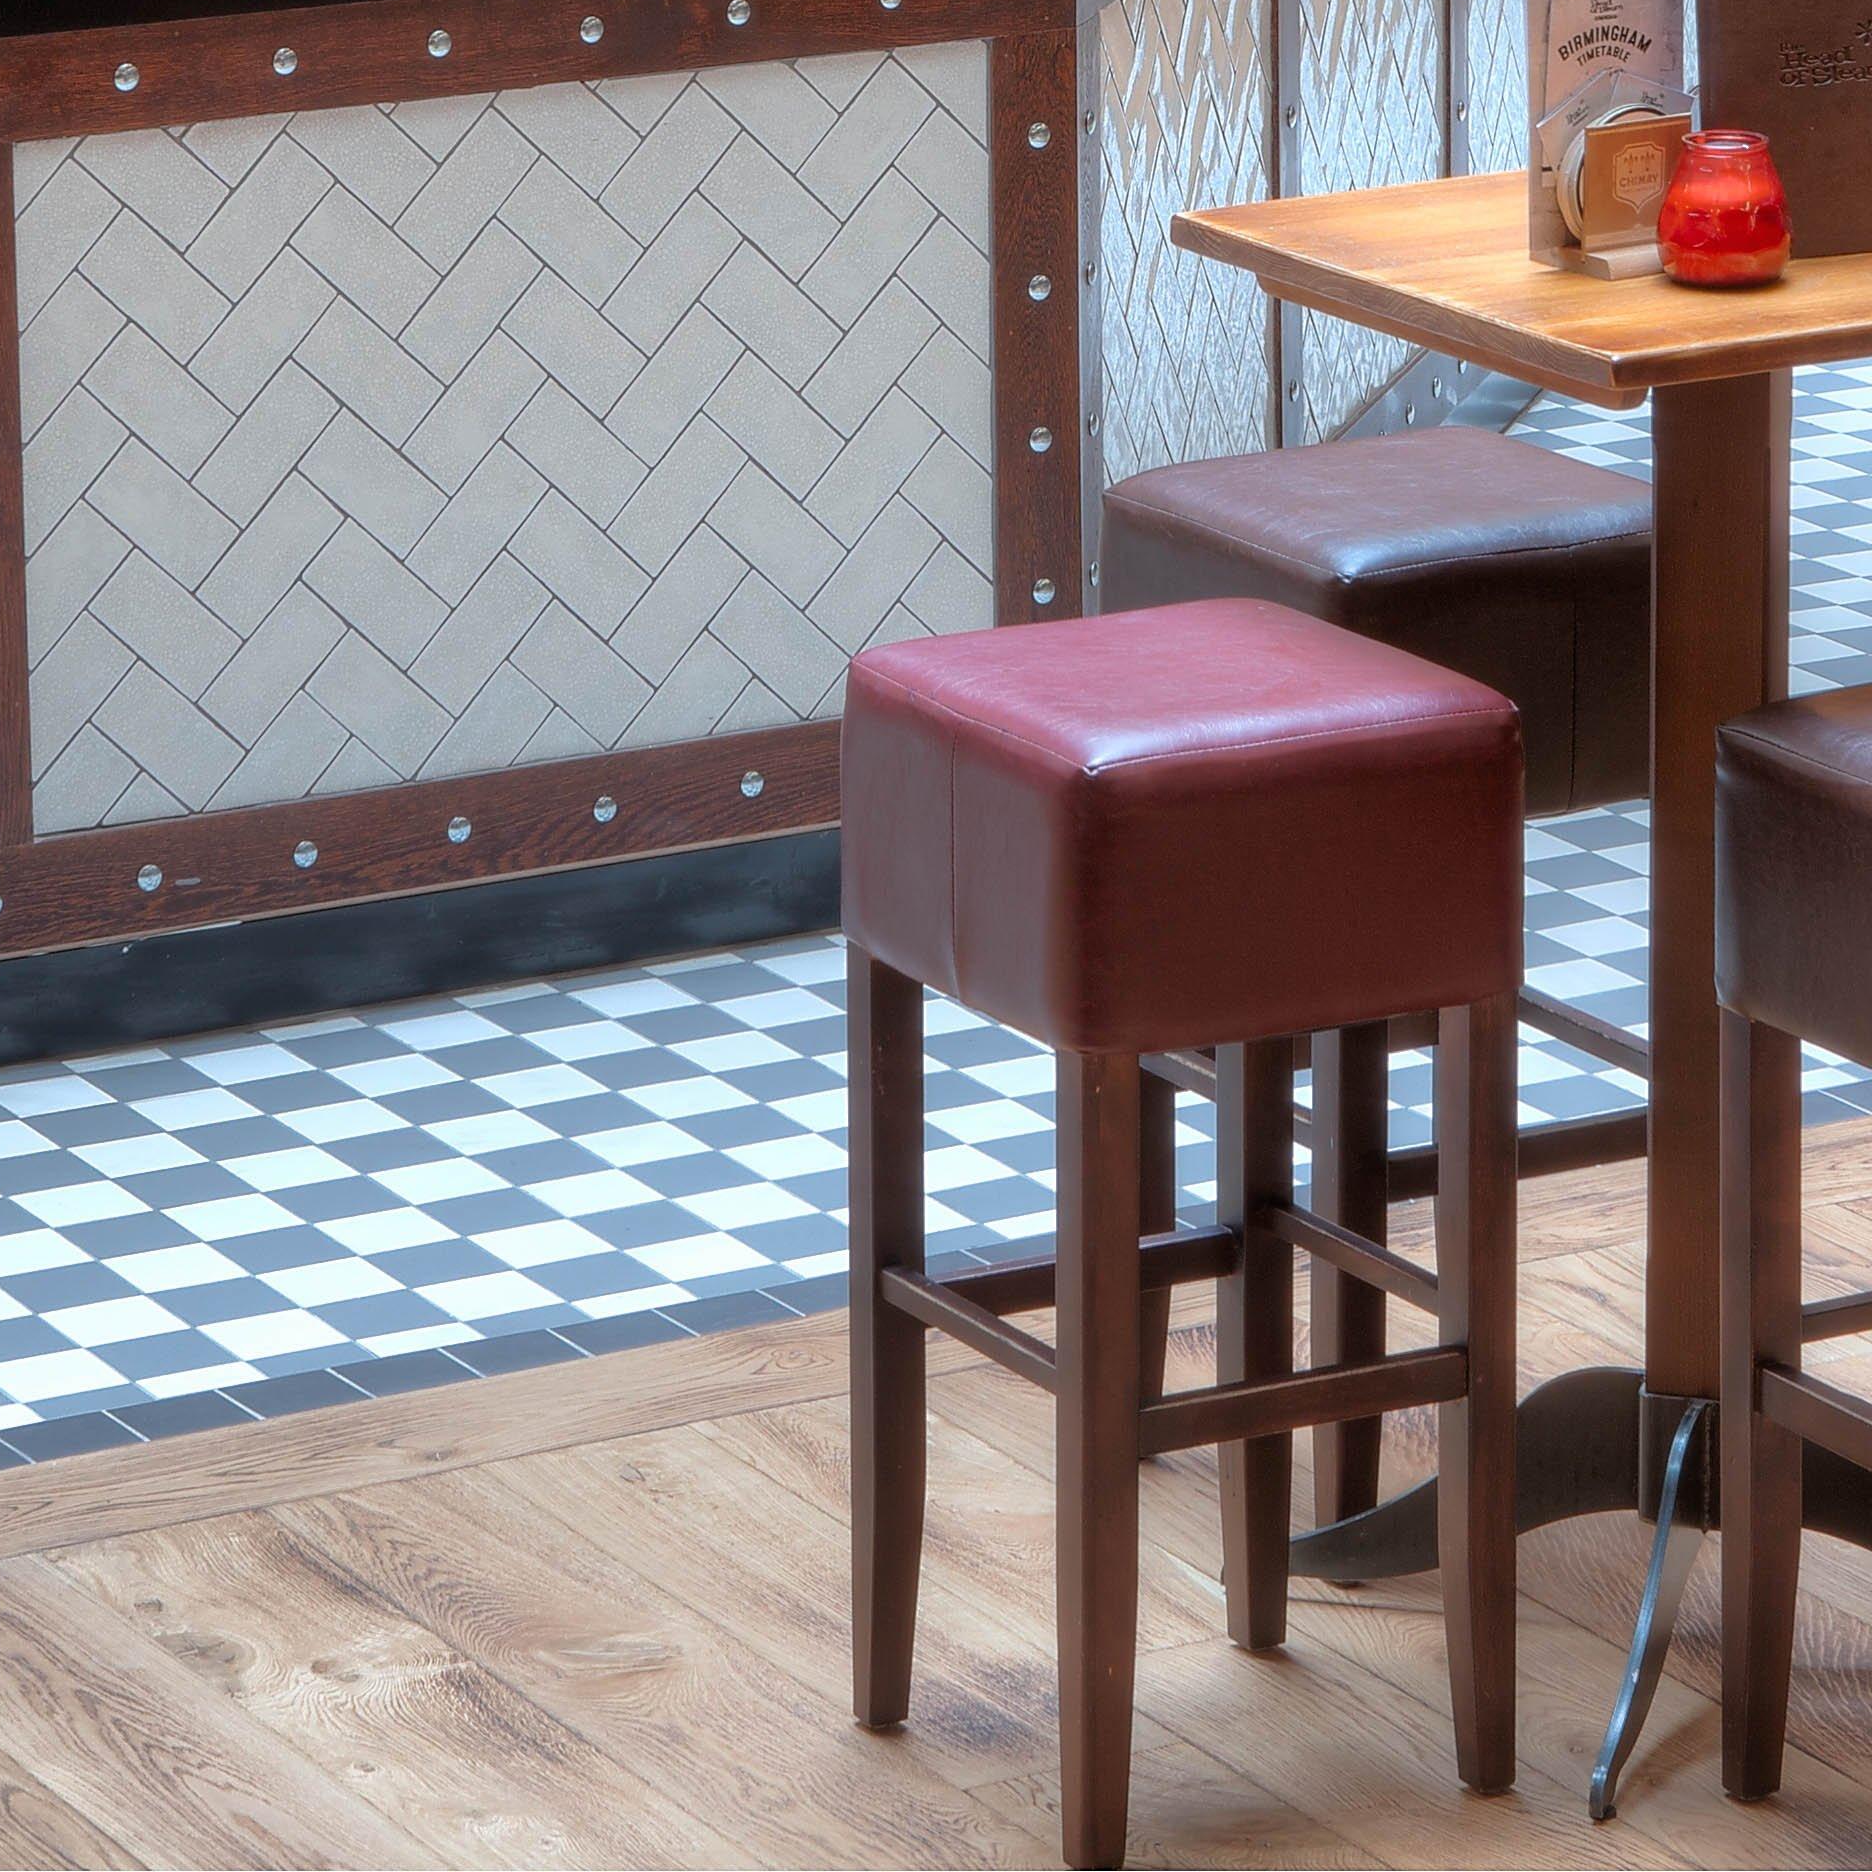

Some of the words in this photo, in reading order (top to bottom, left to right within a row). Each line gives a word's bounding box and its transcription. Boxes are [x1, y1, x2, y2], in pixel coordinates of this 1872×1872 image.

[1557, 24, 1653, 62] BIRMINGHAM
[1576, 44, 1632, 67] TIMETABLE
[1779, 44, 1857, 69] Head
[1618, 173, 1658, 188] CHIMAY
